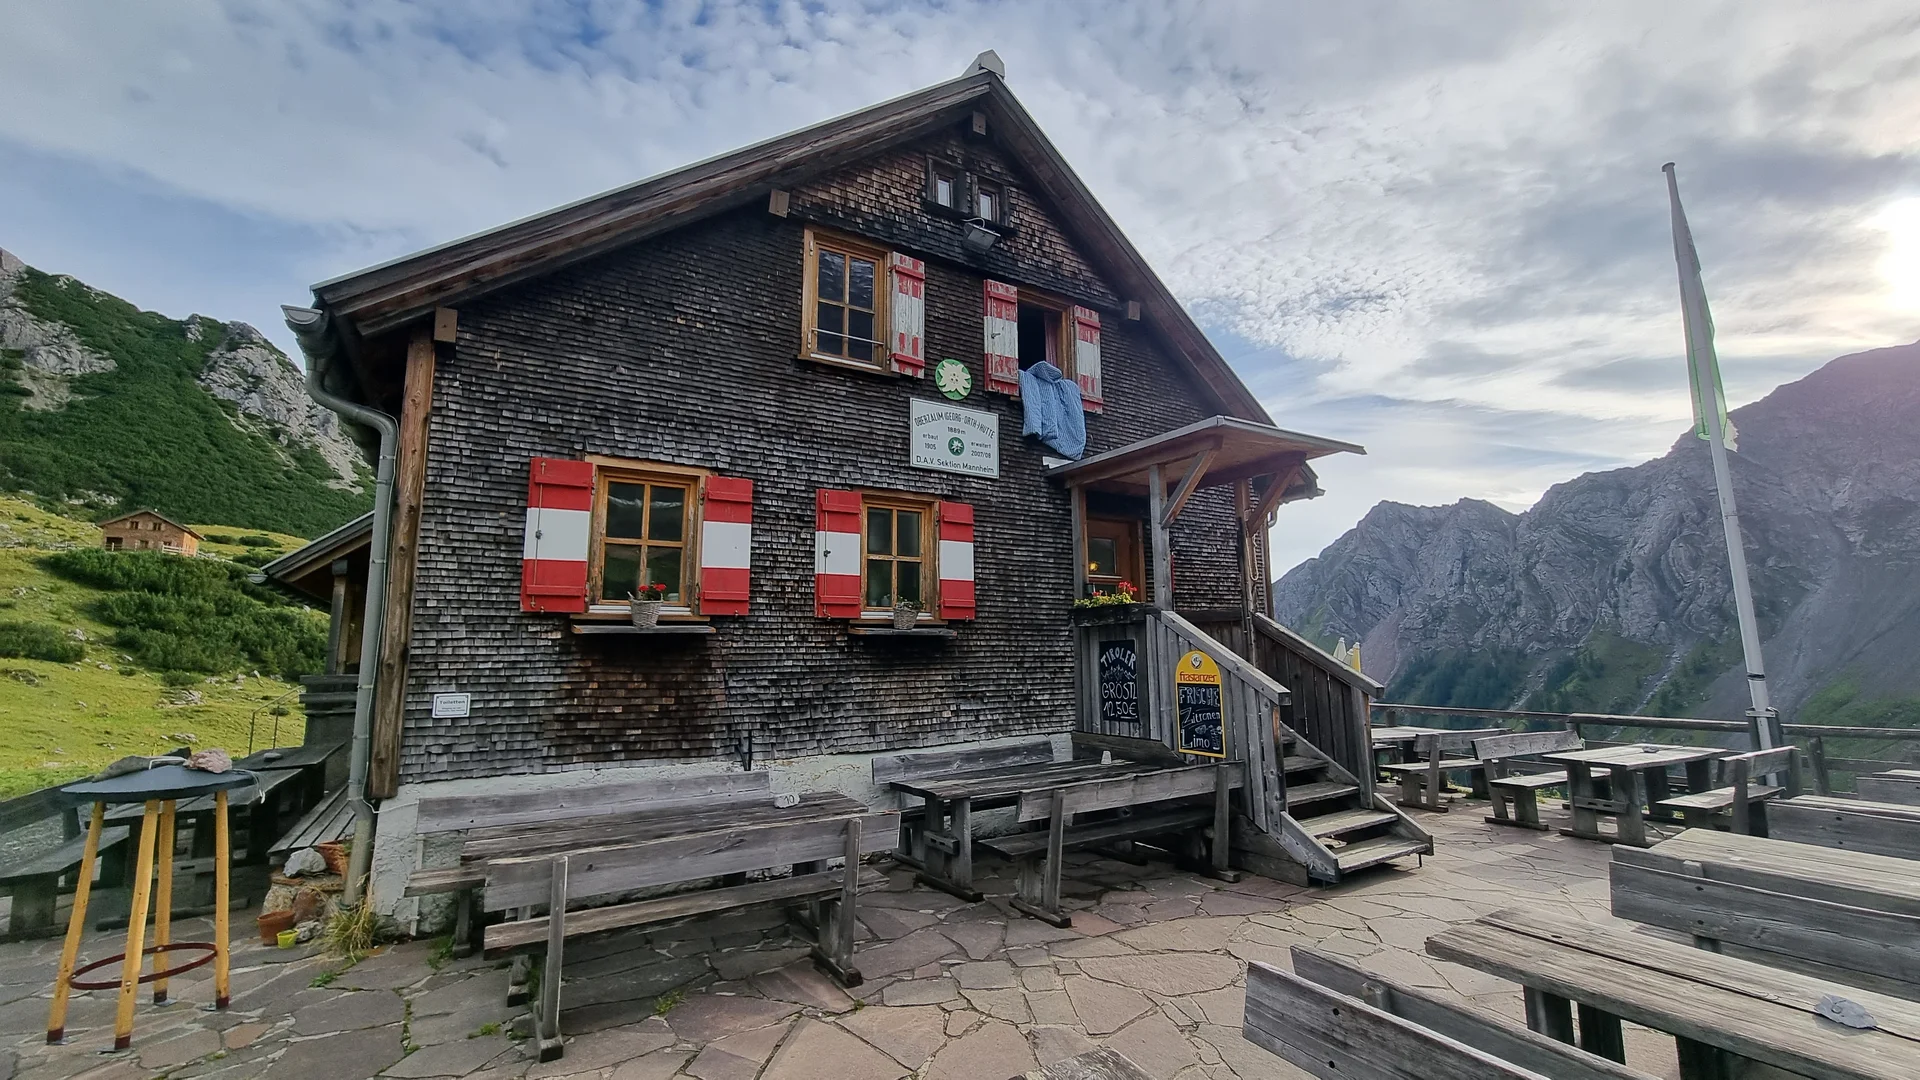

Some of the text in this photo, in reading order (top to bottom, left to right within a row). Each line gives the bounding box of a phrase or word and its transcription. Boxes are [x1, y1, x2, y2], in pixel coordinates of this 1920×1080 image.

[922, 433, 939, 441] erbaut
[947, 426, 961, 435] 1889
[924, 442, 937, 451] 1905
[970, 441, 992, 450] erweitert
[970, 450, 992, 459] 2007/08
[916, 455, 995, 474] D.A.V. Sektion Mannheim
[1100, 647, 1137, 670] TIROLER
[1102, 681, 1138, 700] GRÖSTL
[1178, 686, 1221, 707] FRISCHE
[1103, 700, 1137, 718] 12,50€
[1180, 706, 1221, 729] Zitronen
[1181, 729, 1211, 749] Limo
